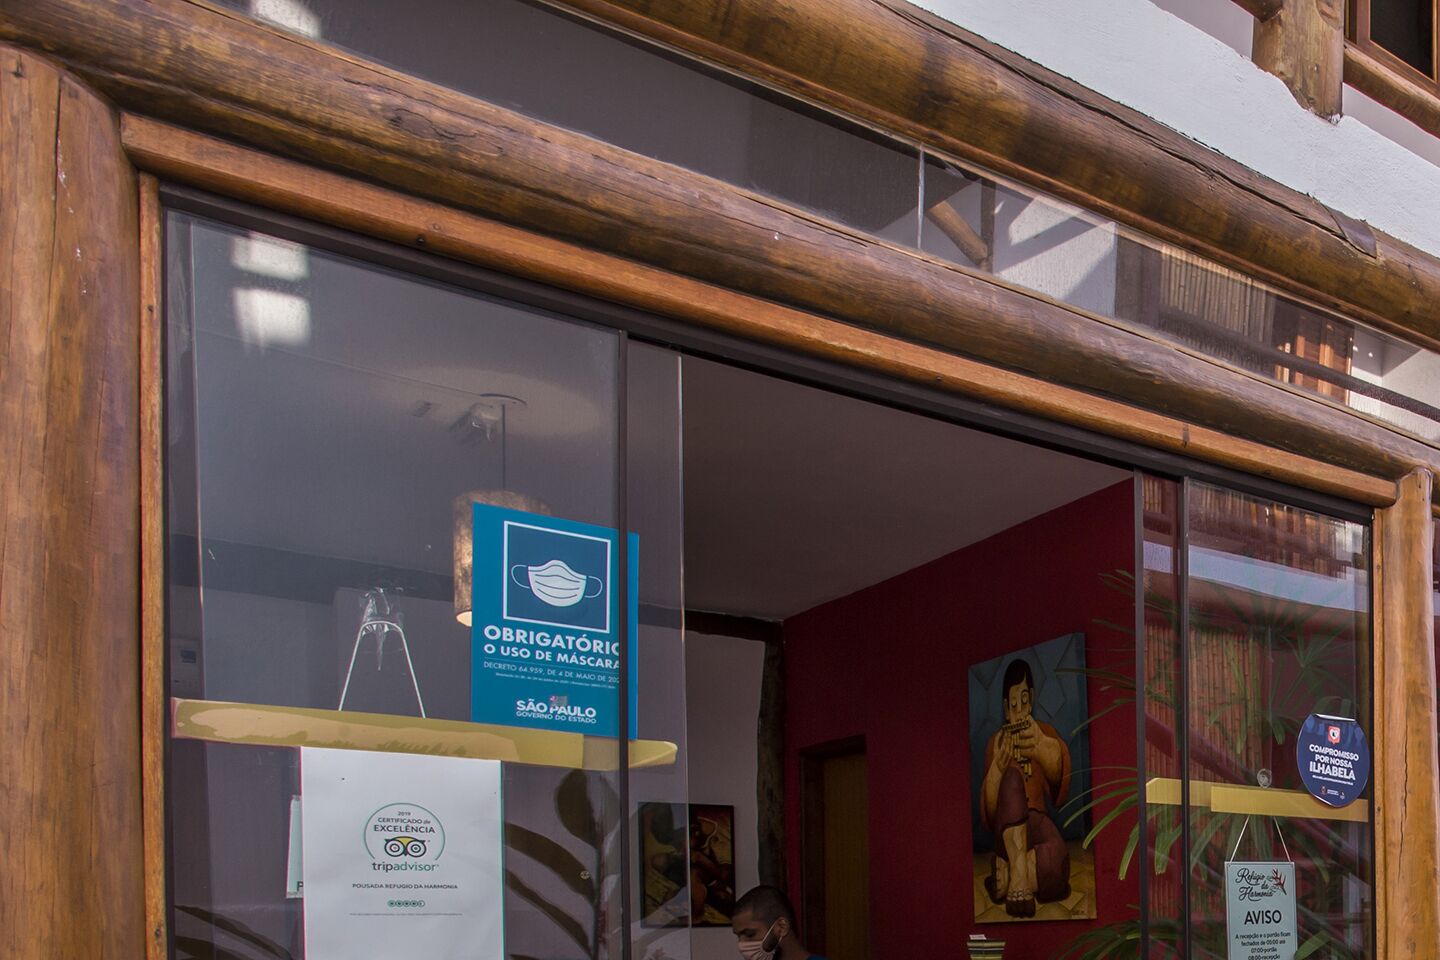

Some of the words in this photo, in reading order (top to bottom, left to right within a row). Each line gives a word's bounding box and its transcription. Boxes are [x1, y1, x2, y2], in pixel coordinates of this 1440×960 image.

[484, 644, 496, 654] O
[500, 646, 530, 658] USO
[536, 650, 552, 662] DE
[484, 661, 517, 672] DECRETO
[547, 668, 556, 676] DE
[565, 670, 573, 678] DE
[576, 672, 596, 681] MAIO
[598, 674, 606, 682] DE
[516, 698, 548, 714] SÃO
[550, 704, 596, 718] PAULO
[516, 712, 553, 720] GOVERNO
[568, 716, 596, 724] ESTADO
[1309, 744, 1359, 761] COMPROMISSO
[1315, 754, 1329, 764] POR
[1330, 757, 1352, 768] NOSSA
[1310, 761, 1356, 780] ILHABELA
[374, 823, 435, 833] EXCELÊNCIA
[372, 861, 437, 873] tripadvisor
[1239, 886, 1273, 901] Harmonia
[1244, 910, 1282, 925] AVISO
